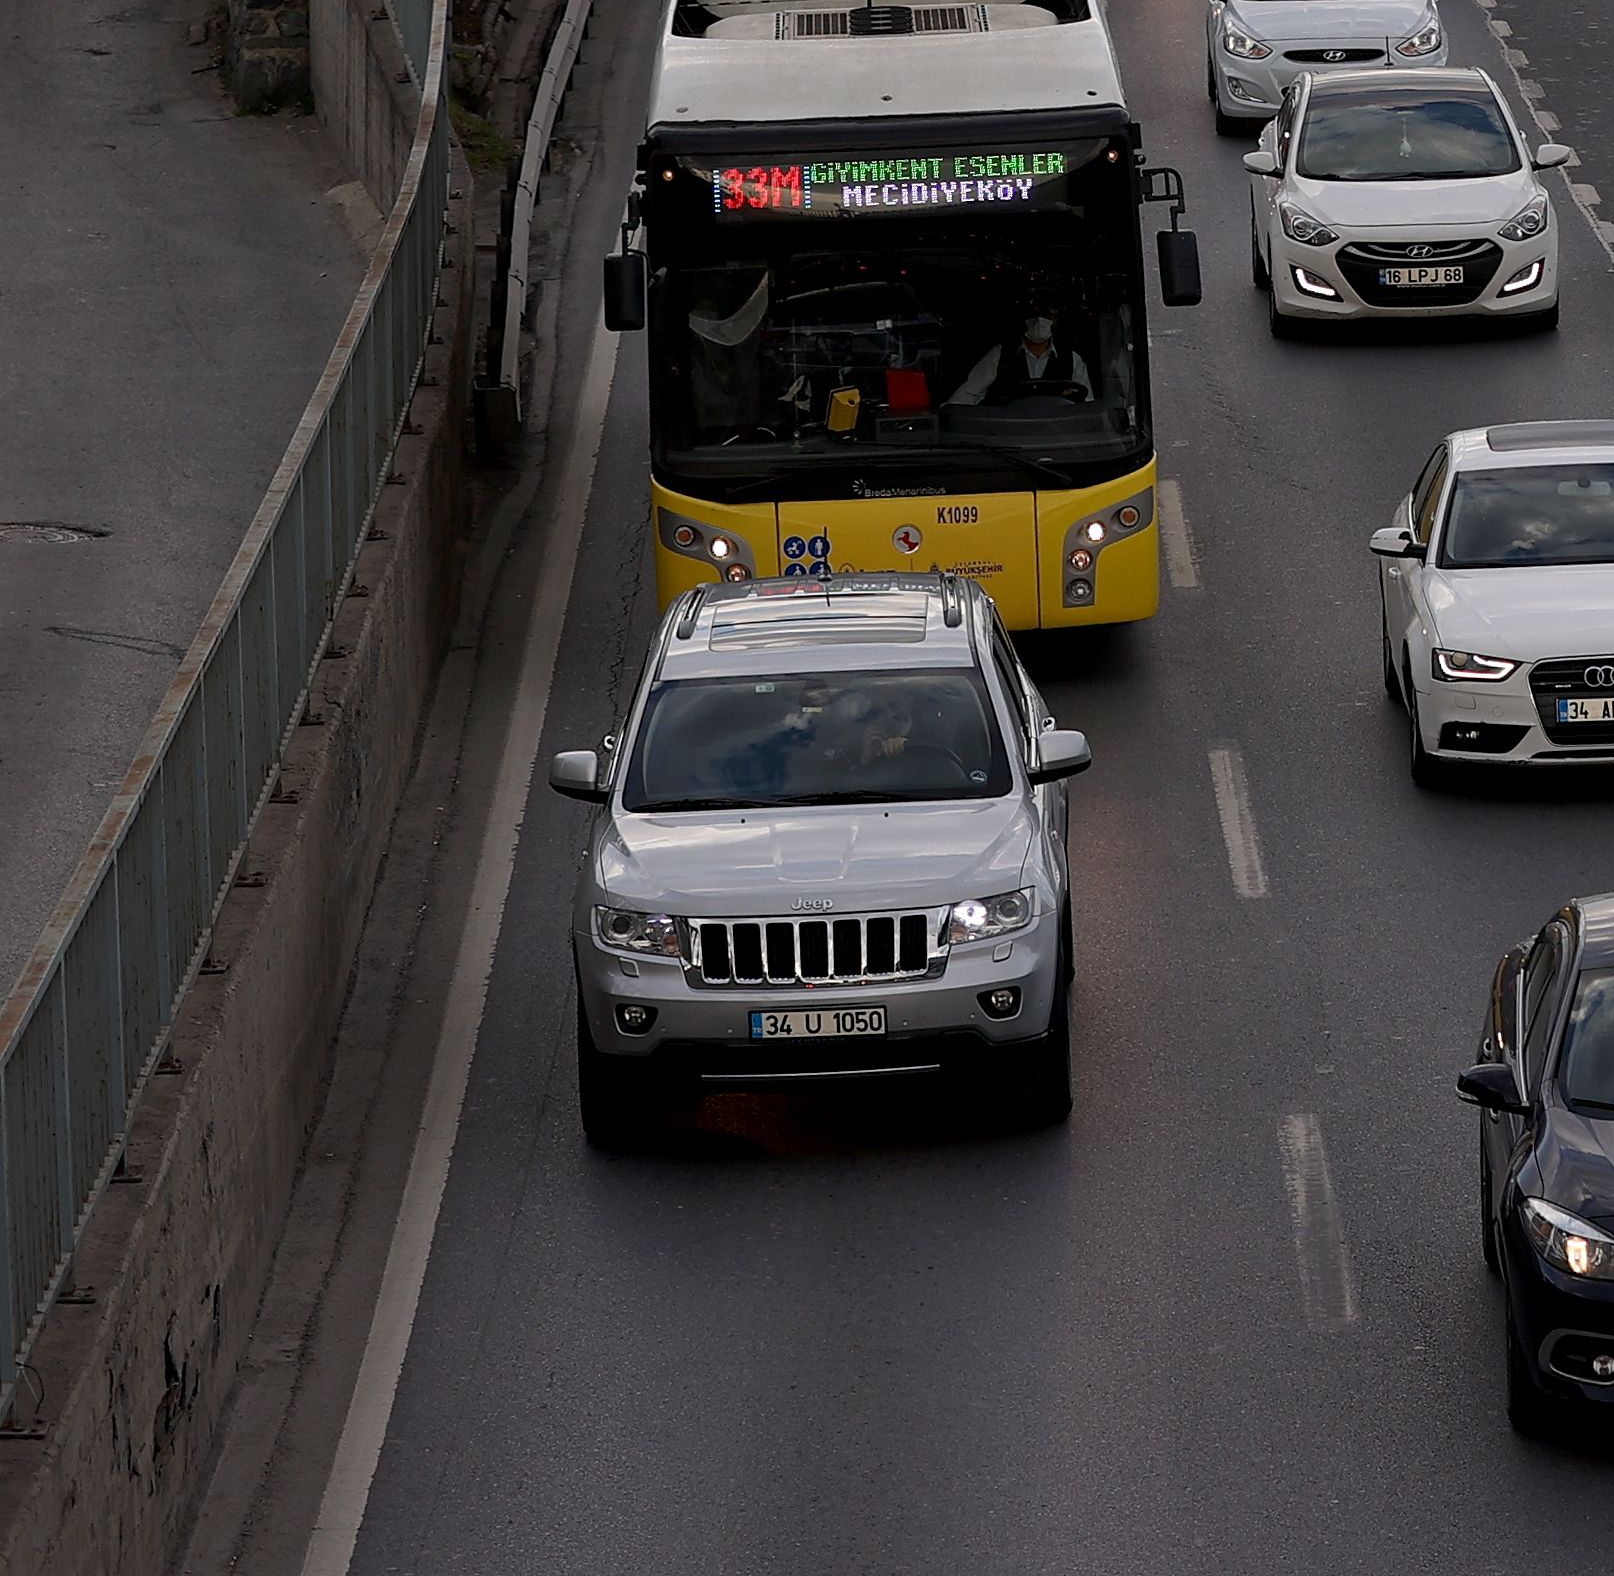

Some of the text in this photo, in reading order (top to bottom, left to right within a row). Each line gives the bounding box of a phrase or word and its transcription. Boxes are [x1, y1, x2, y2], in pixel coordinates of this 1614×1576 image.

[722, 165, 801, 209] 33M
[1387, 268, 1462, 283] 16 LPJ 68
[937, 506, 978, 524] K1099
[1569, 702, 1589, 720] 34
[765, 1015, 793, 1036] 34
[805, 1013, 822, 1034] U
[833, 1011, 883, 1032] 1050
